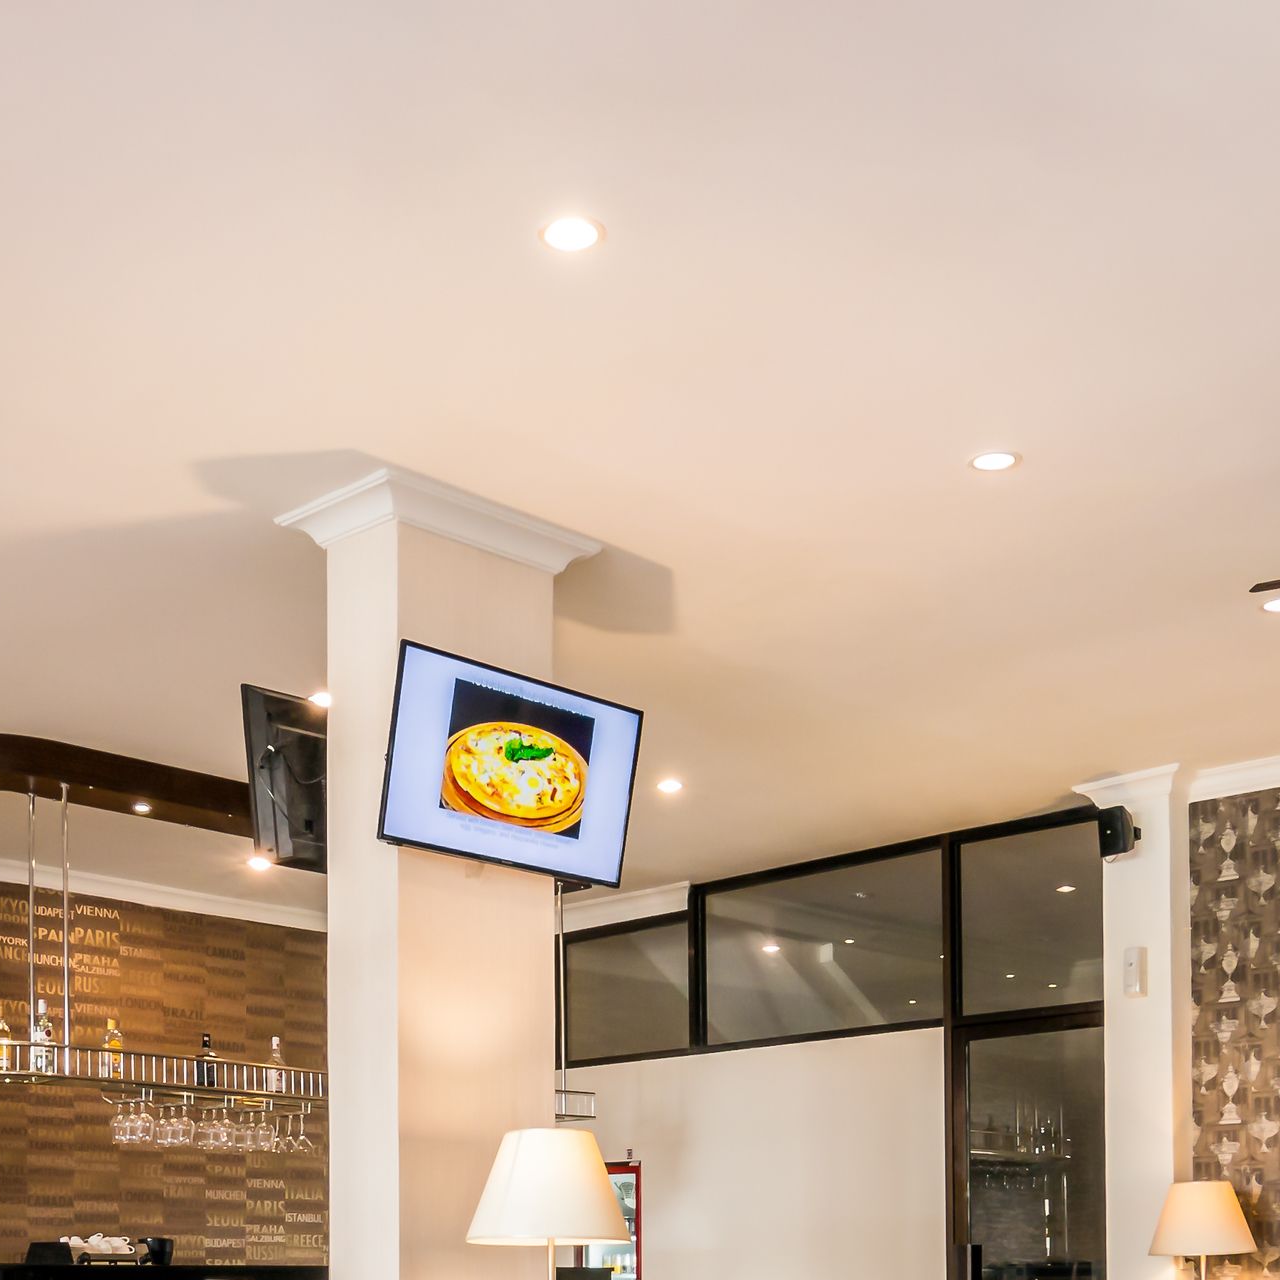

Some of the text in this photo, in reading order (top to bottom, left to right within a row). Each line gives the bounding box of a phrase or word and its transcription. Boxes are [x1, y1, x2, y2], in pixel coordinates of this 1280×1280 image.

[75, 904, 120, 920] VIENNA
[74, 927, 120, 949] PARIS
[205, 945, 245, 961] CANADA
[74, 953, 120, 968] PRAHA
[74, 964, 120, 977] SALZBURG
[74, 1002, 120, 1017] VIENNA
[162, 1006, 204, 1021] BRAZIL
[206, 1164, 246, 1177] SPAIN
[164, 1176, 206, 1185] NEWYORK
[246, 1178, 286, 1189] VIENNA
[205, 1189, 247, 1201] MUNCHEN
[285, 1187, 324, 1200] ITALIA
[74, 1201, 120, 1213] VIENNA
[246, 1200, 287, 1217] PARIS
[206, 1211, 247, 1227] SEOUL
[285, 1212, 323, 1223] ISTANBUL
[246, 1224, 286, 1235] PRAHA
[205, 1238, 246, 1249] BUDAPEST
[246, 1234, 286, 1243] SALZBURG
[286, 1234, 324, 1248] GREECE
